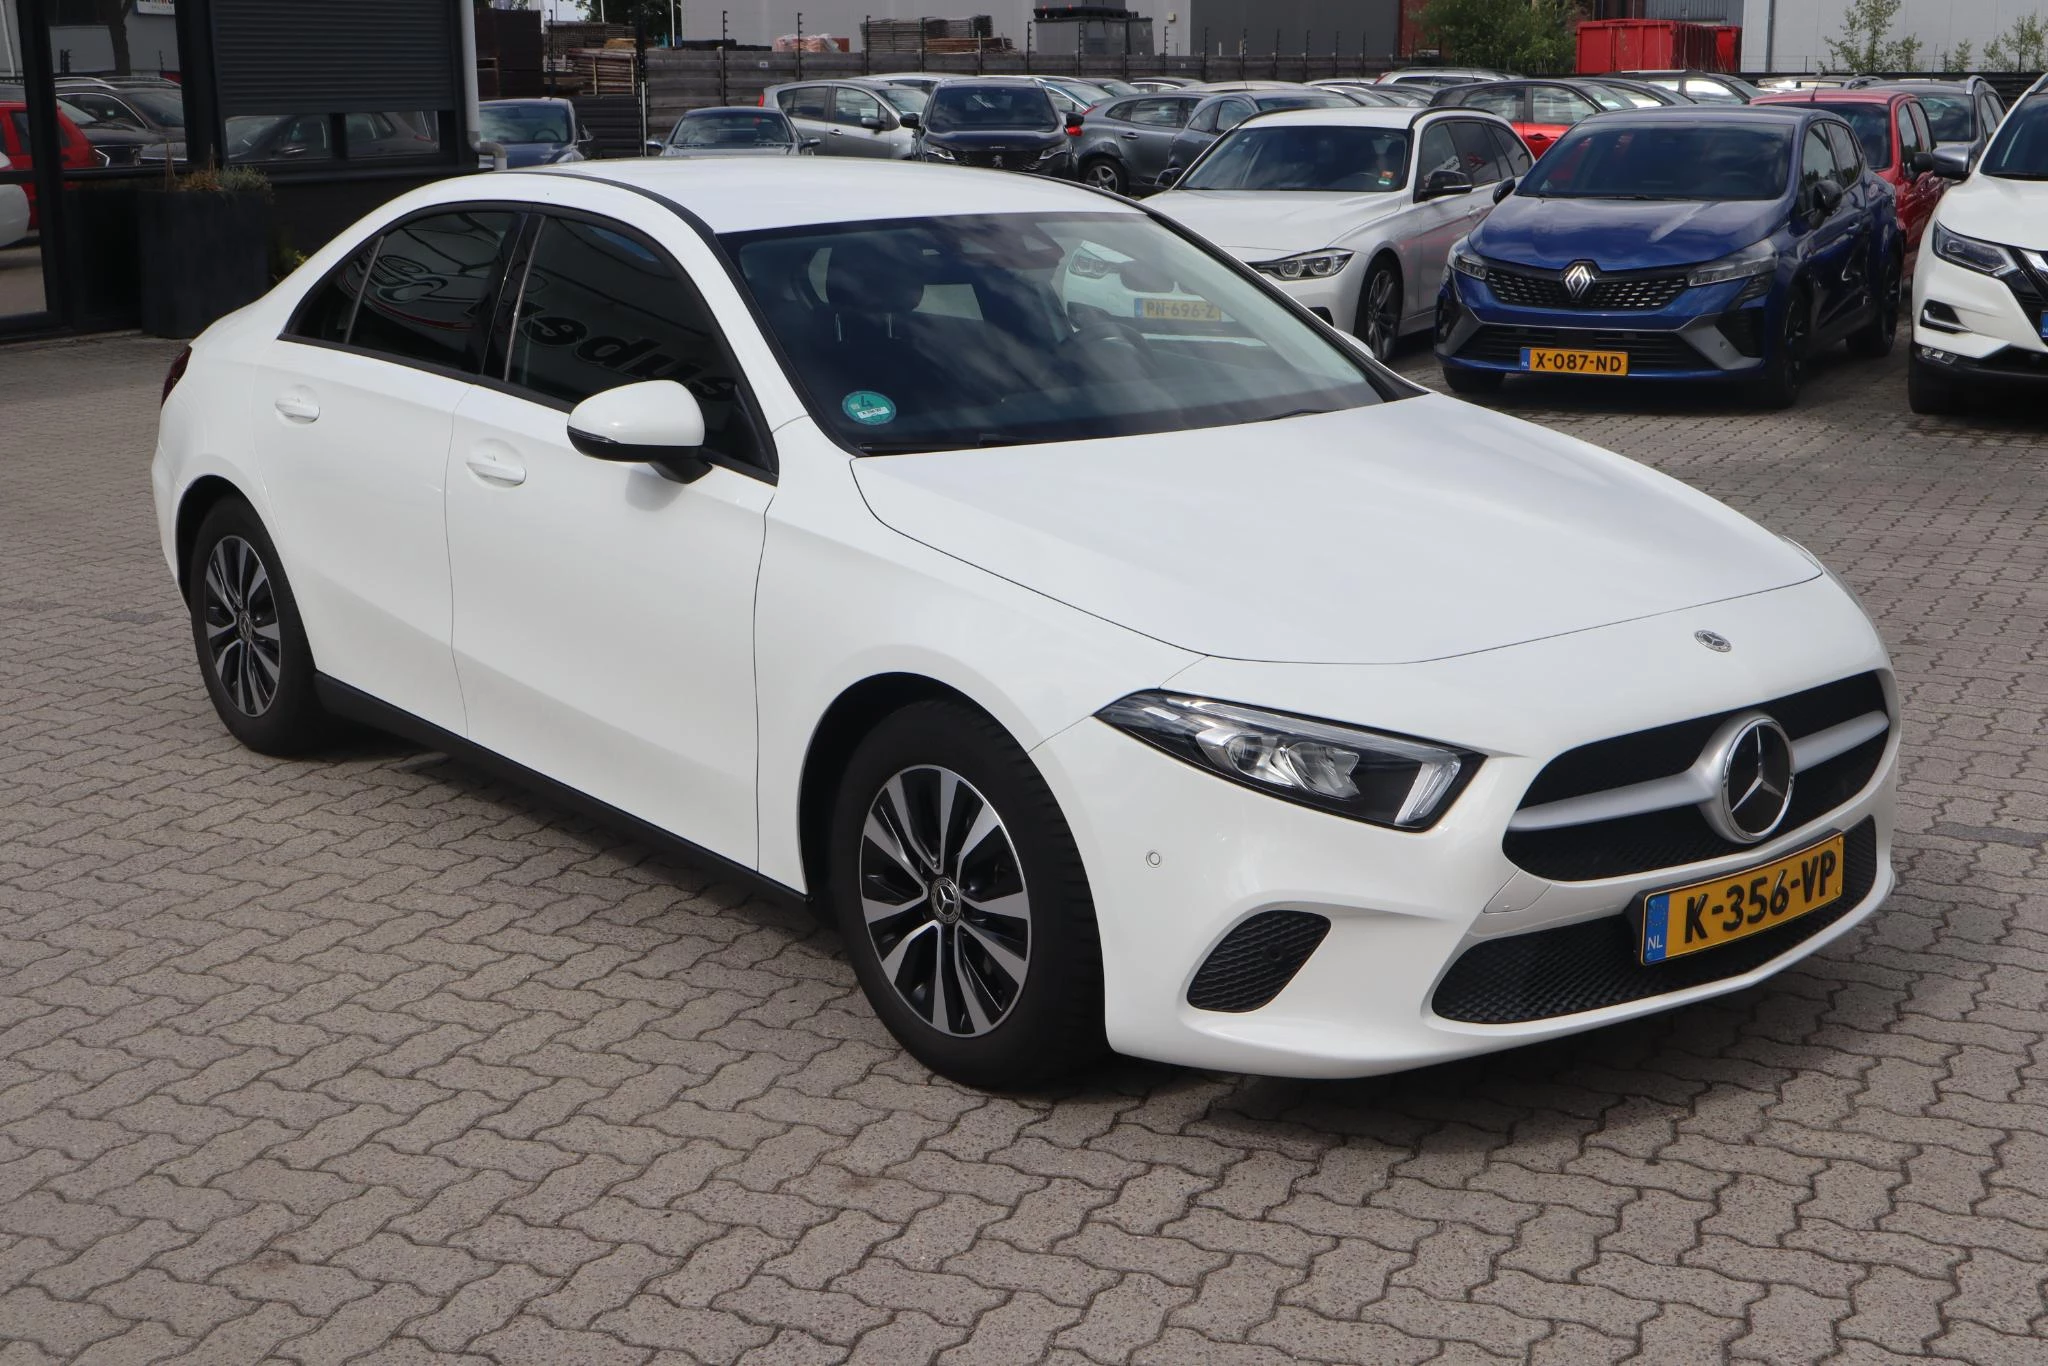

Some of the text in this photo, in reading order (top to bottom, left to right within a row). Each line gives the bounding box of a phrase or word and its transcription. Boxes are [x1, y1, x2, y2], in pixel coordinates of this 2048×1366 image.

[1146, 302, 1215, 319] PN-696-Z
[1536, 353, 1621, 371] X-087-ND
[1684, 850, 1836, 943] K-356-VP
[1647, 935, 1663, 949] NL
